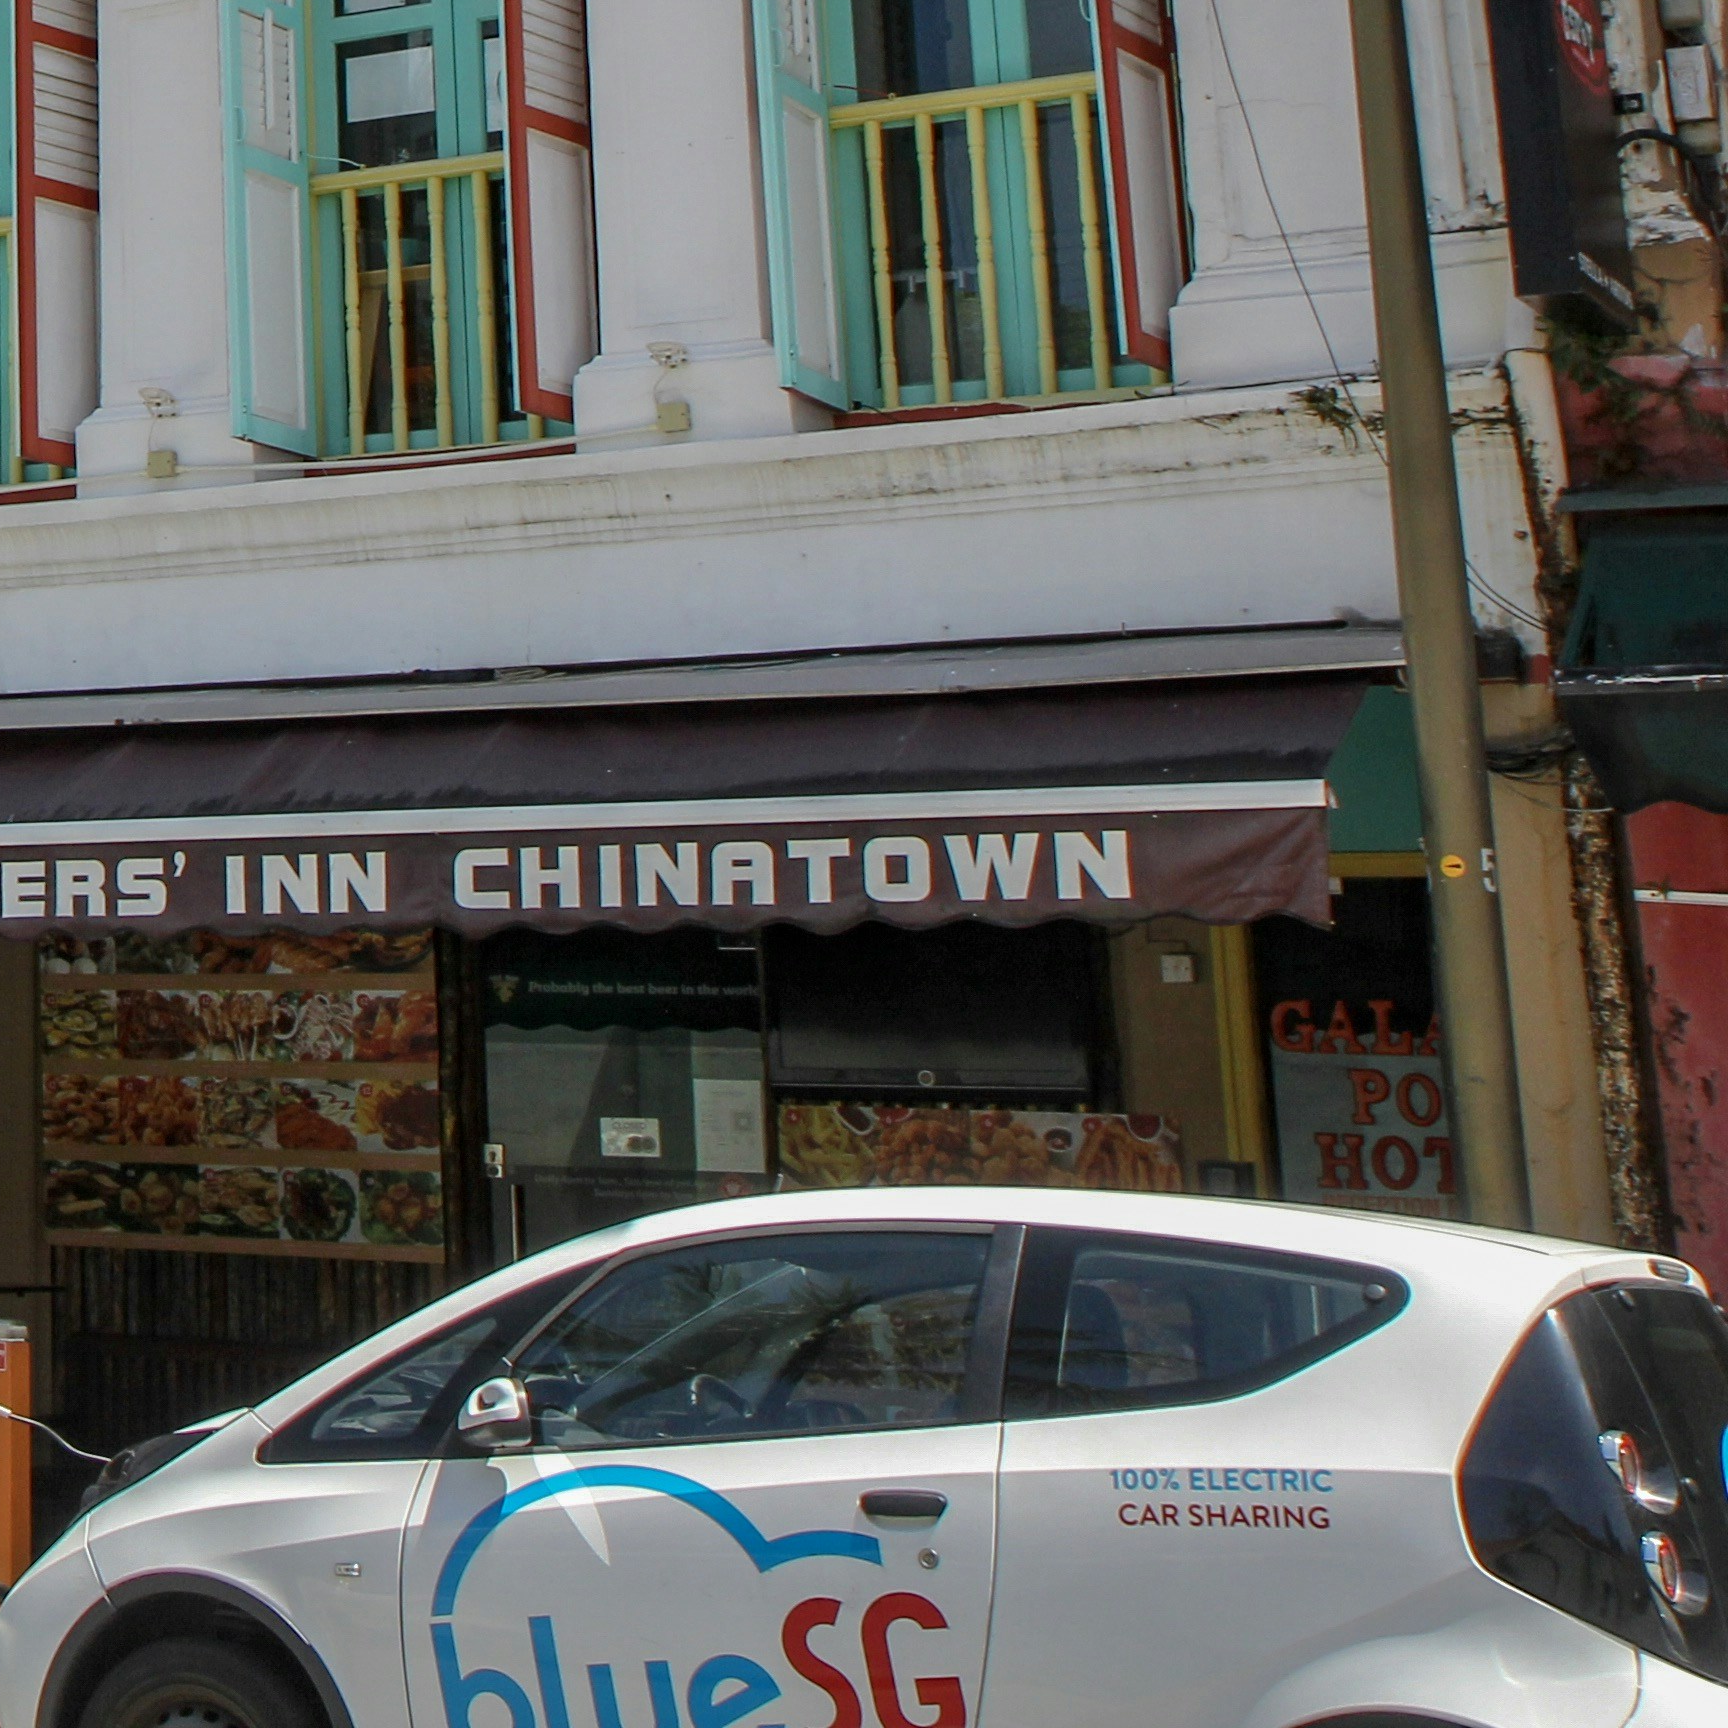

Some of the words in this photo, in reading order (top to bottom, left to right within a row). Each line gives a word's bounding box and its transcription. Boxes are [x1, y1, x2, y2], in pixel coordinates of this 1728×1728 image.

[225, 850, 387, 915] INN
[453, 830, 1132, 910] CHINATOWN
[527, 981, 590, 996] Probably
[592, 981, 613, 994] the
[616, 981, 645, 995] best
[647, 982, 679, 995] beer
[680, 983, 695, 995] in
[696, 983, 720, 995] the
[1109, 1468, 1181, 1491] 100%
[1188, 1468, 1334, 1493] ELECTRIC
[1117, 1503, 1180, 1527] CAR
[1187, 1504, 1331, 1529] SHARING
[430, 1591, 967, 1728] blueSG
